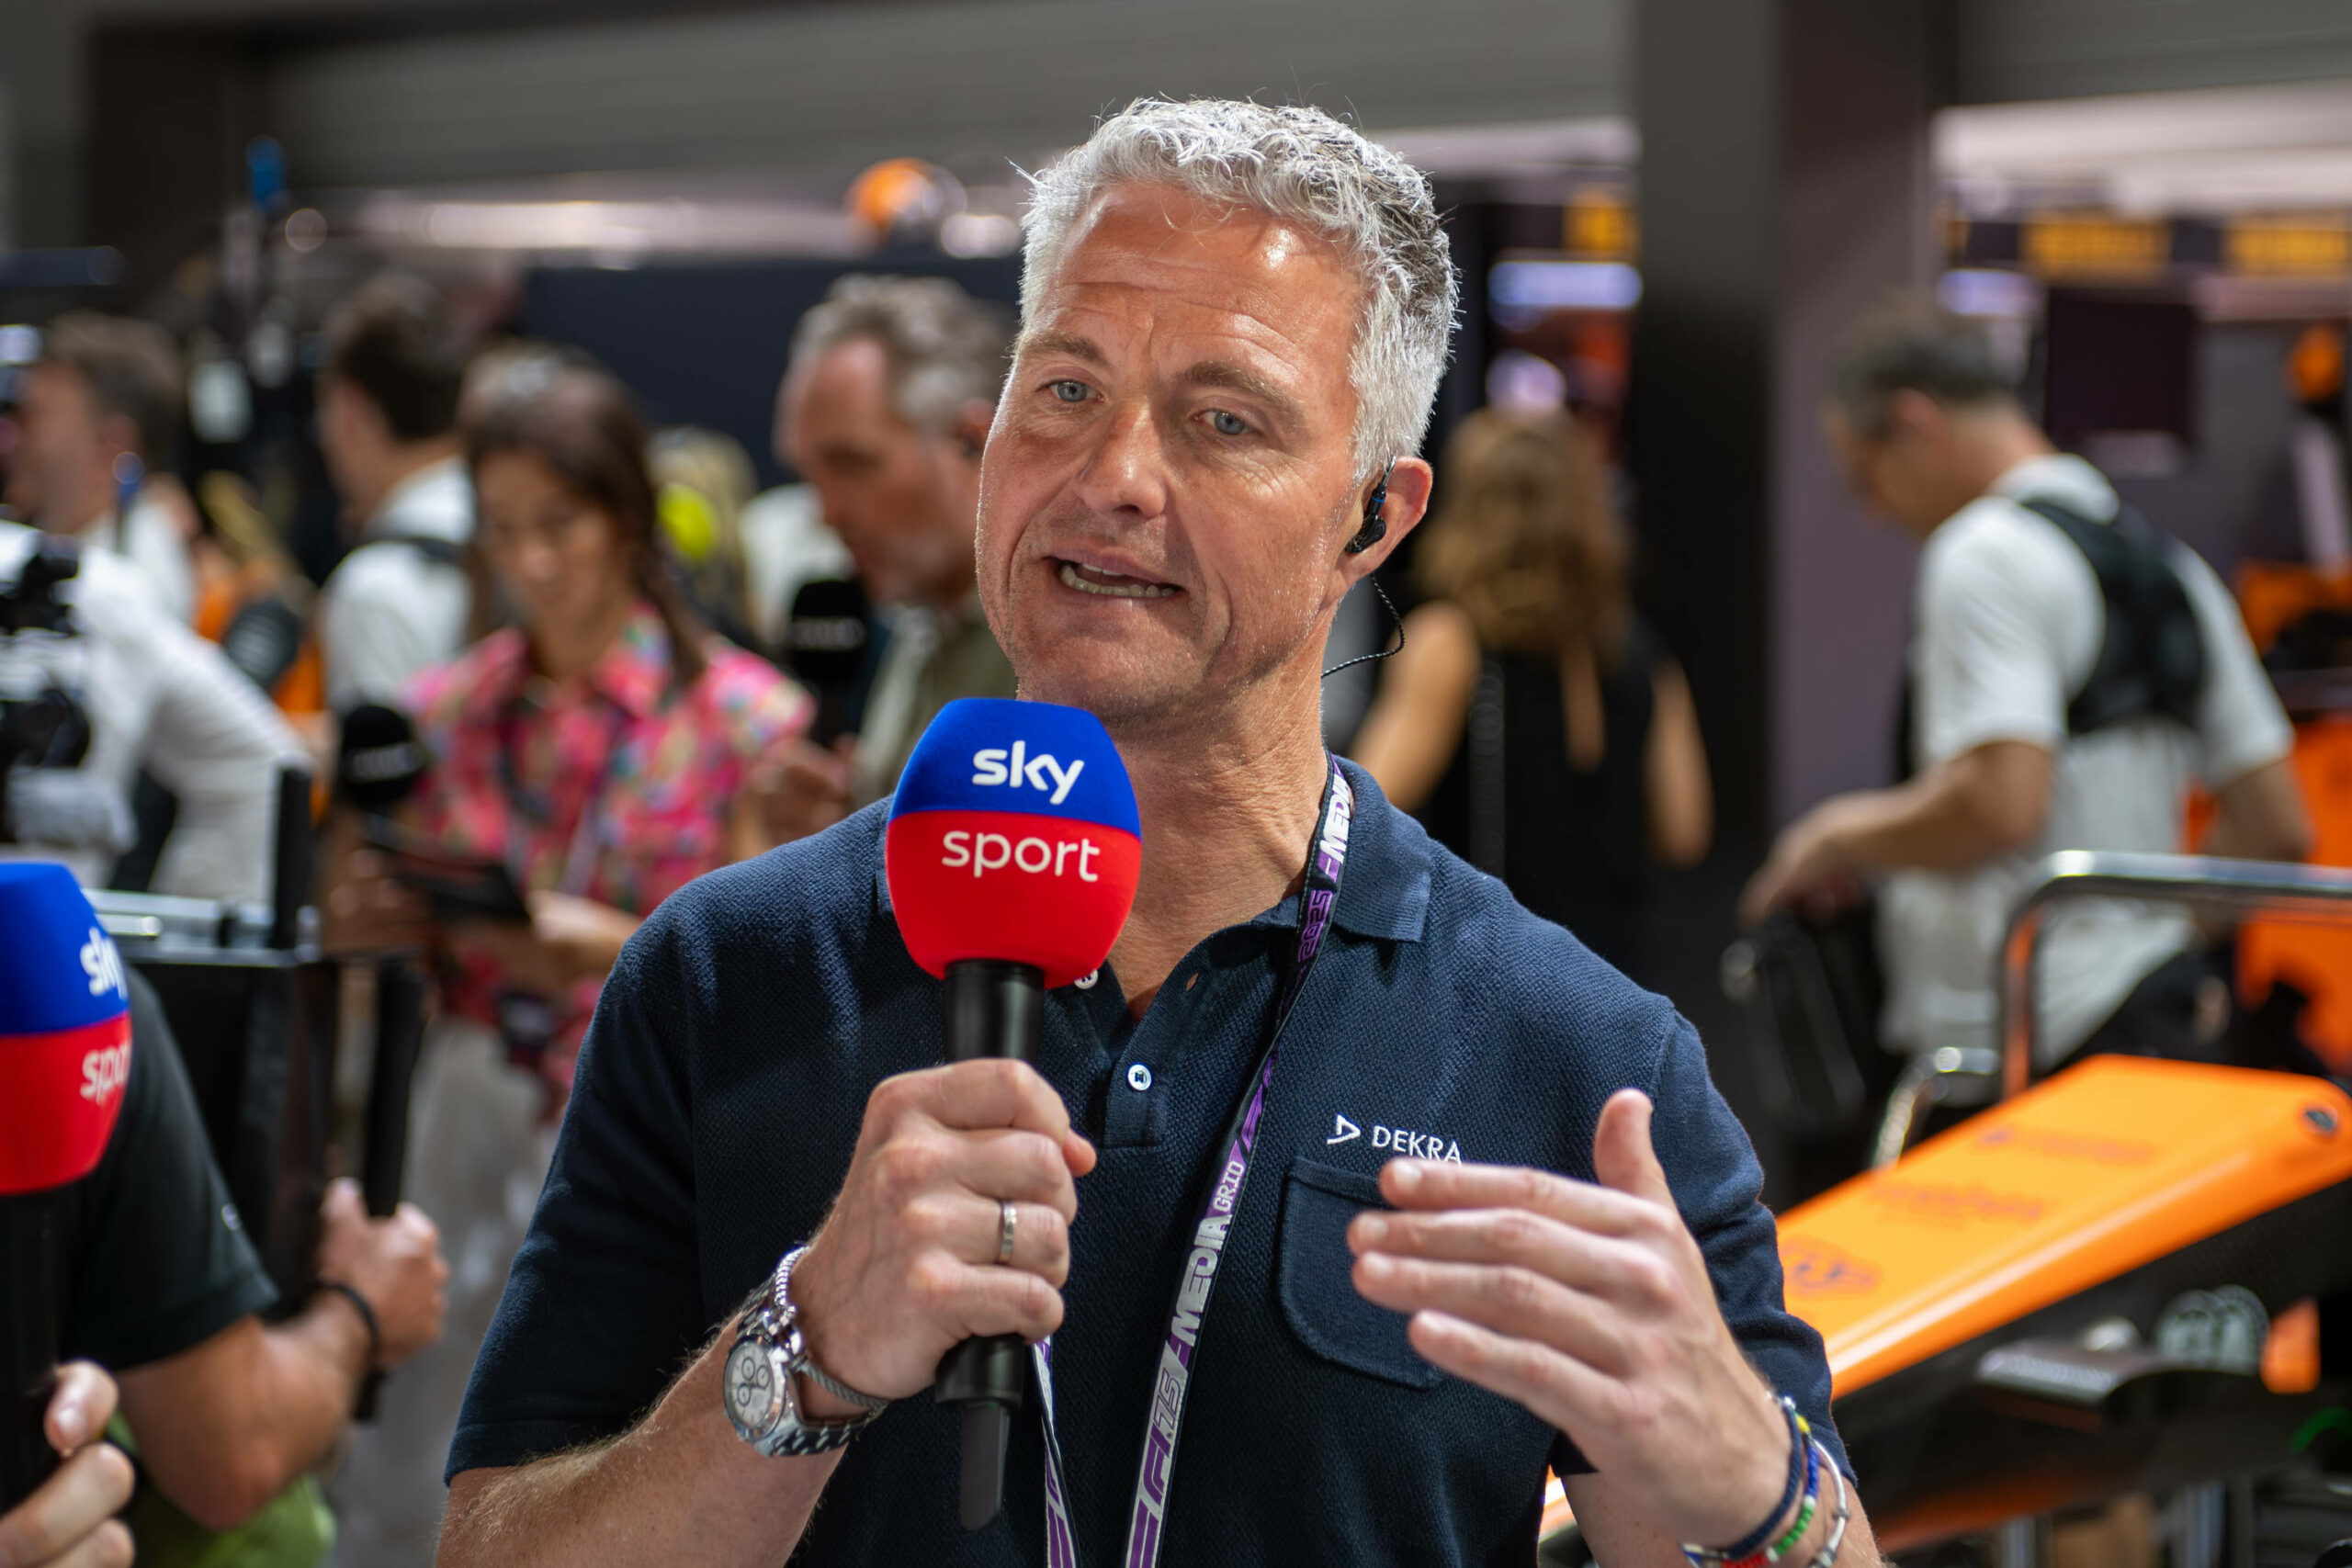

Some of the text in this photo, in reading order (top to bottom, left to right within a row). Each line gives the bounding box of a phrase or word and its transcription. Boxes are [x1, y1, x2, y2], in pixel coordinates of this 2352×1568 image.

[972, 740, 1085, 805] sky
[942, 830, 1100, 882] sport
[1297, 889, 1333, 963] 2025
[1372, 1125, 1462, 1168] DEKRA
[1171, 1213, 1233, 1348] MEDIA
[1213, 1160, 1244, 1213] GRID
